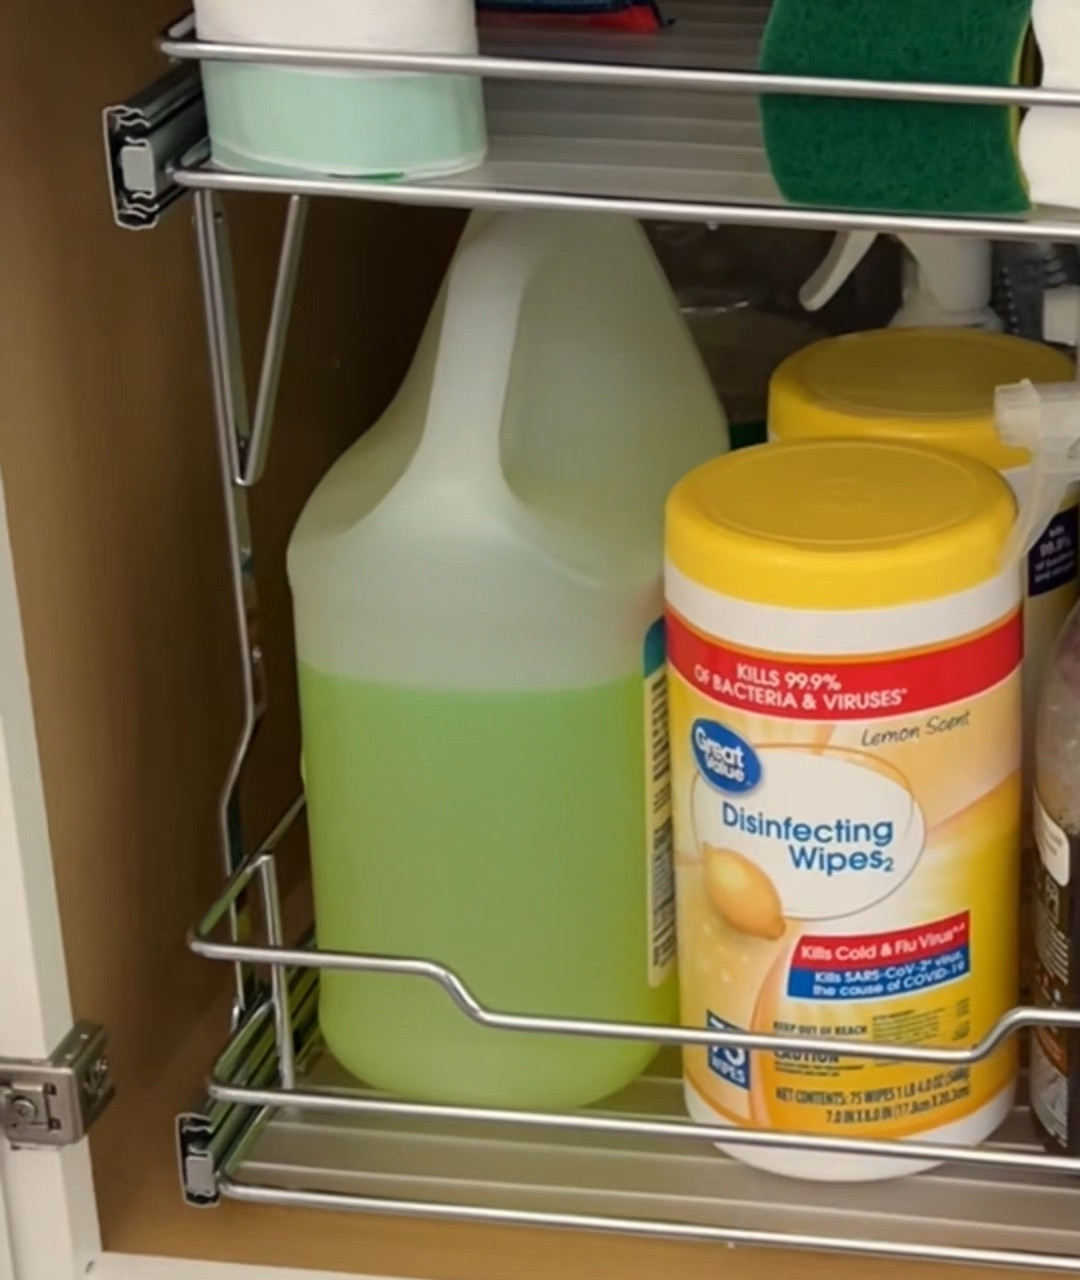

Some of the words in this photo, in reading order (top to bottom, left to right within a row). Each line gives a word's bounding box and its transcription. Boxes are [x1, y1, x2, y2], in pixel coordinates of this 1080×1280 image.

[694, 664, 709, 684] OF
[713, 675, 798, 709] BACTERIA
[802, 693, 816, 710] &
[736, 663, 780, 687] KILLS
[784, 672, 842, 691] 99.9%
[861, 722, 920, 747] Lemon
[926, 711, 971, 734] Scent
[695, 726, 744, 768] Great
[704, 752, 745, 783] Value
[722, 802, 893, 846] Disinfecting
[801, 943, 832, 960] Kills
[835, 943, 877, 961] Cold
[880, 942, 892, 956] &
[895, 938, 917, 955] Flu
[812, 984, 836, 997] the
[839, 983, 884, 997] cause
[886, 979, 900, 992] of
[903, 961, 966, 989] COVID-19
[814, 971, 842, 984] Kills
[773, 1022, 796, 1032] KEEP
[799, 1024, 818, 1035] OUT
[835, 1024, 867, 1035] REACH
[711, 1057, 746, 1084] WIPES
[776, 1087, 793, 1101] NET
[864, 1087, 895, 1104] WIPES
